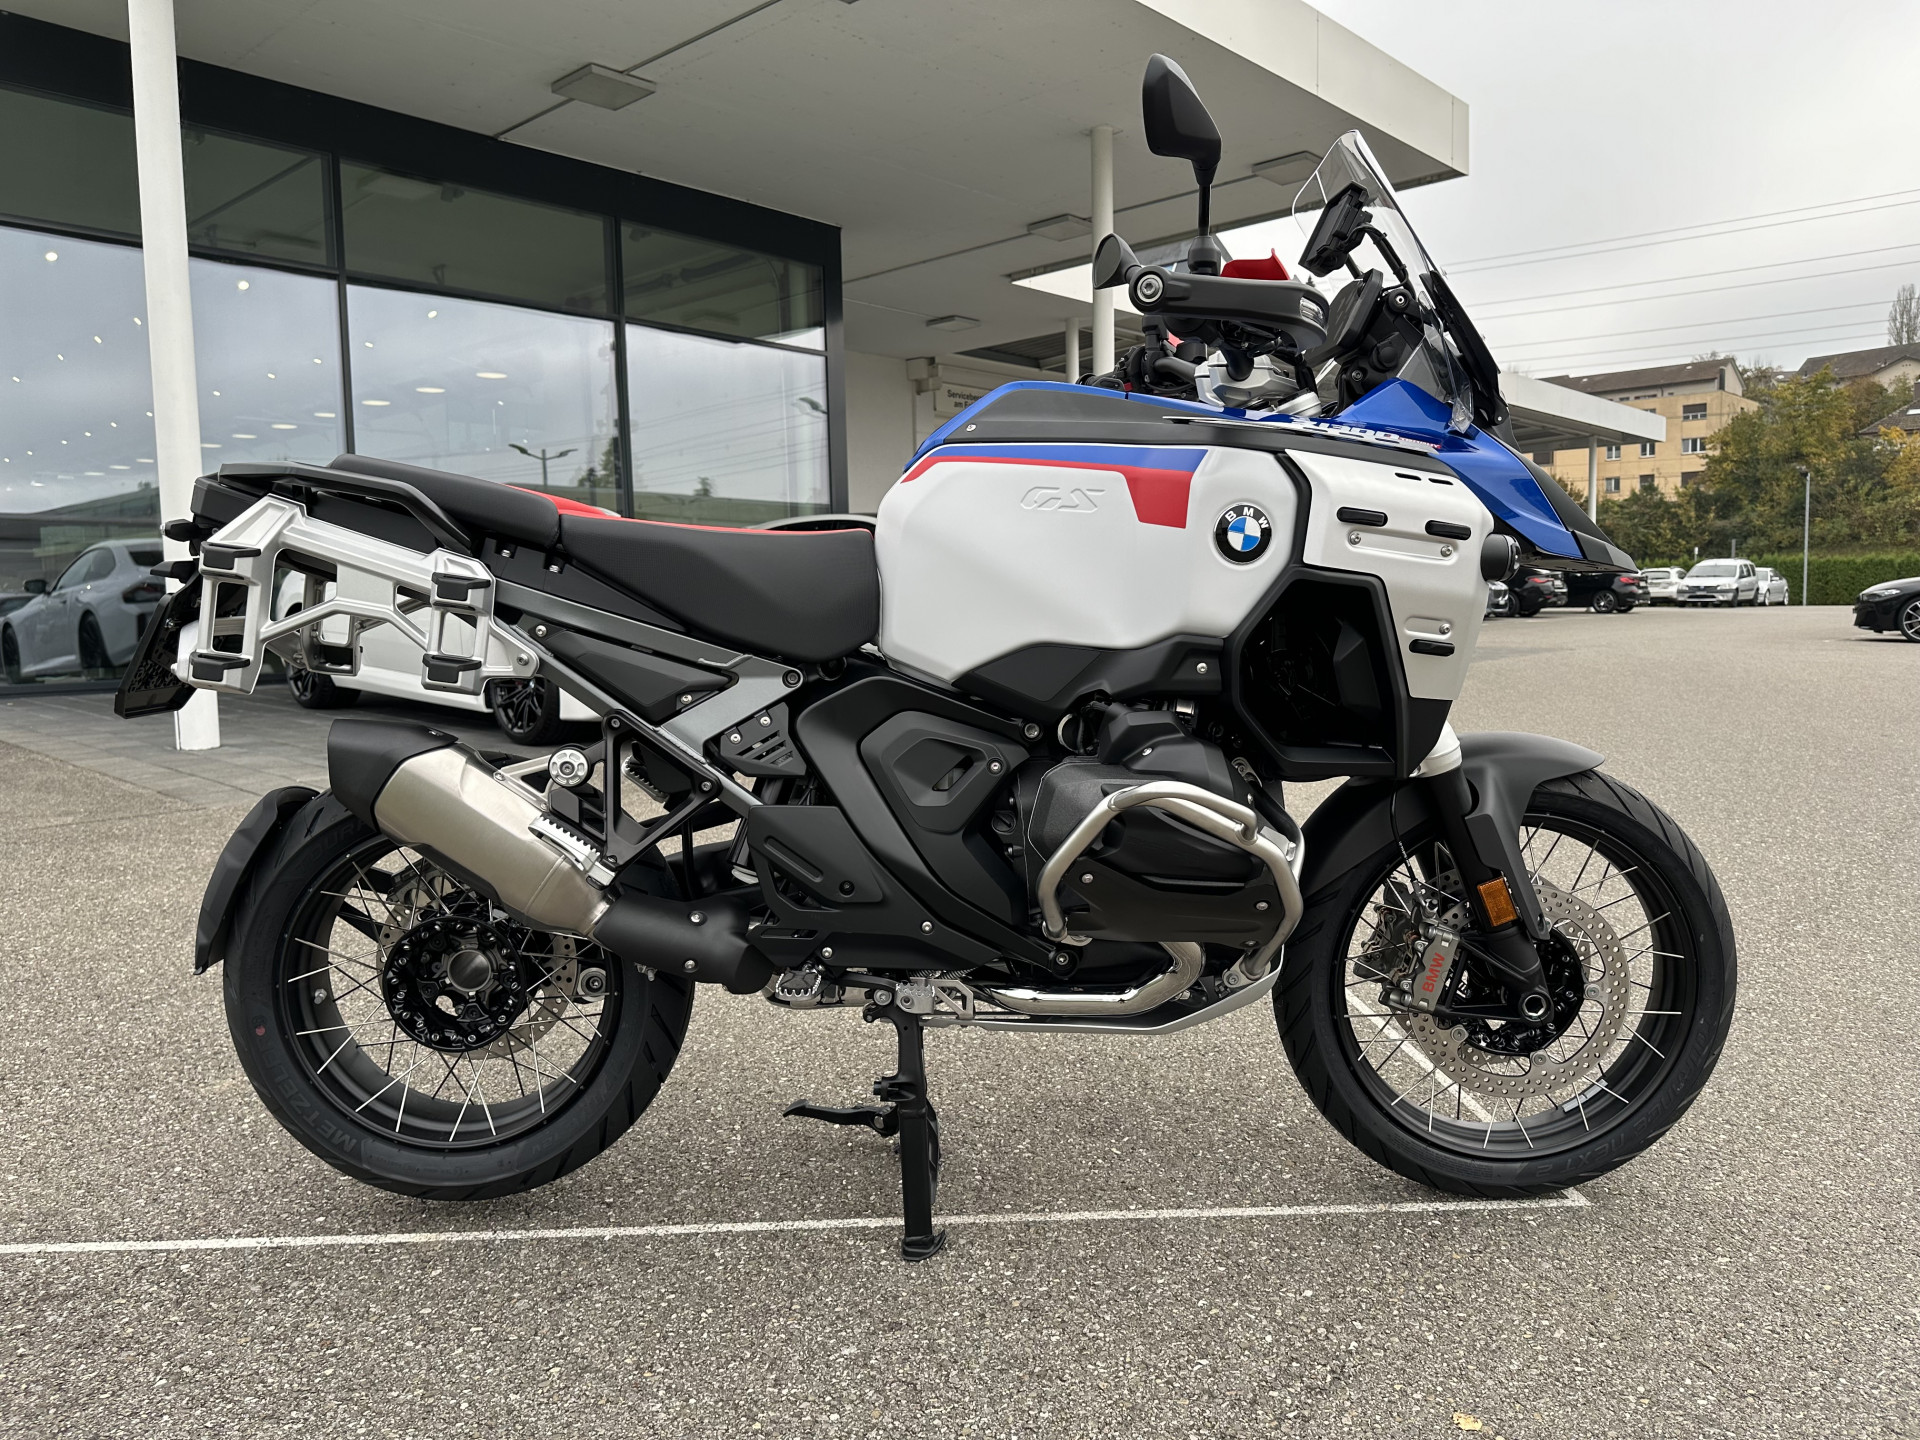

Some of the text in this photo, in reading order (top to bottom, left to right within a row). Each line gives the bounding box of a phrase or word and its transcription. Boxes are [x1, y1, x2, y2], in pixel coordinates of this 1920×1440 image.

[1020, 486, 1105, 513] GS
[1224, 506, 1270, 529] BMW
[1421, 952, 1446, 993] BMW
